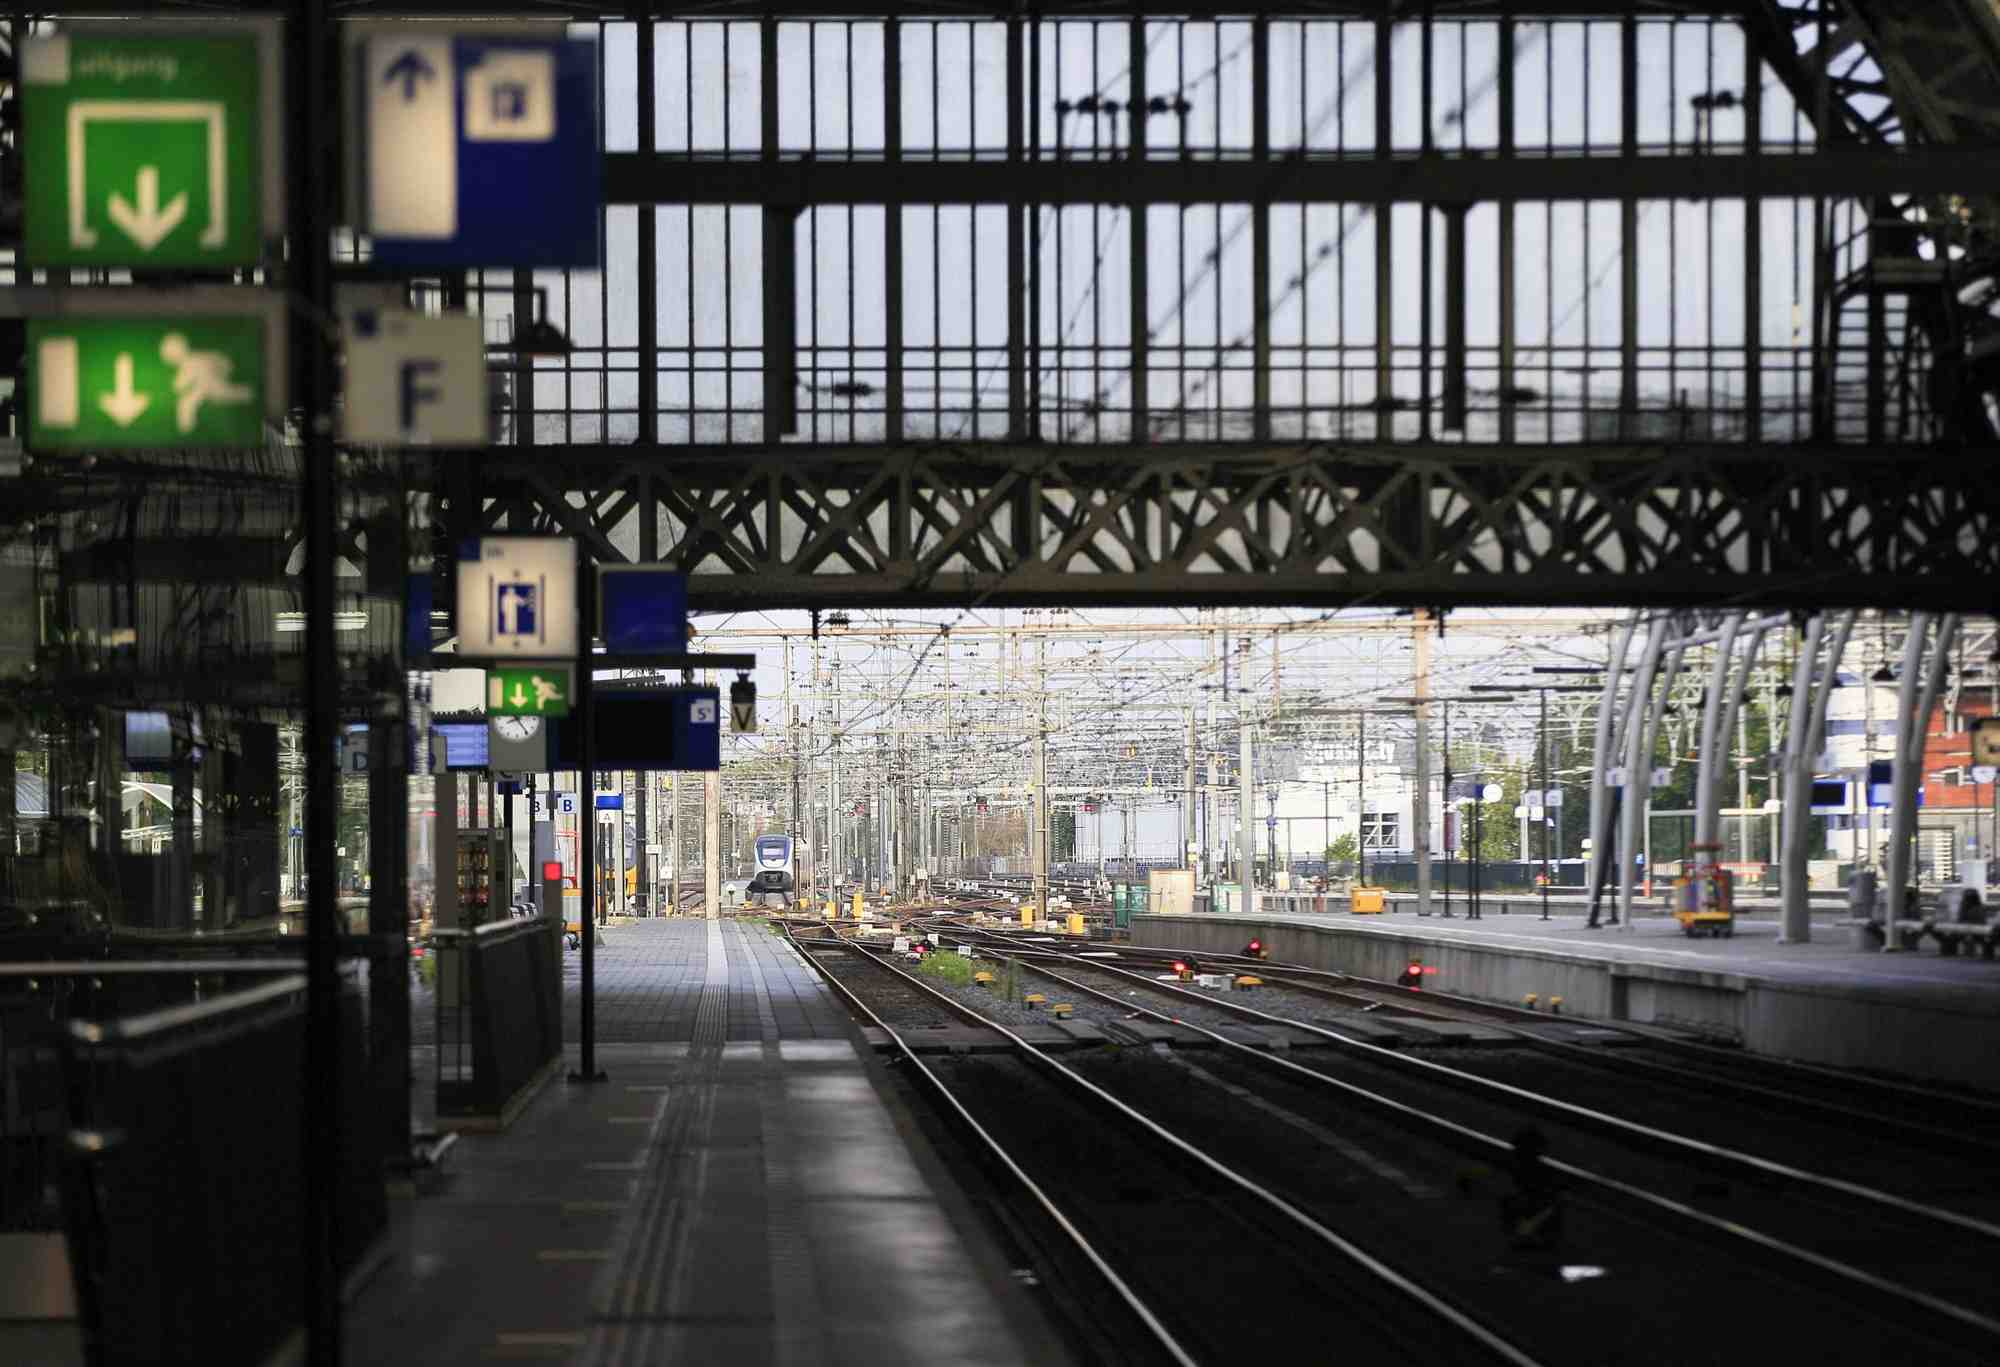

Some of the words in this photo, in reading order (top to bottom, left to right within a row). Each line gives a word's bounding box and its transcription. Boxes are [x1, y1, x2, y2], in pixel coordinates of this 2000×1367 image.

[400, 358, 444, 430] F
[733, 705, 753, 730] V
[563, 800, 572, 812] B
